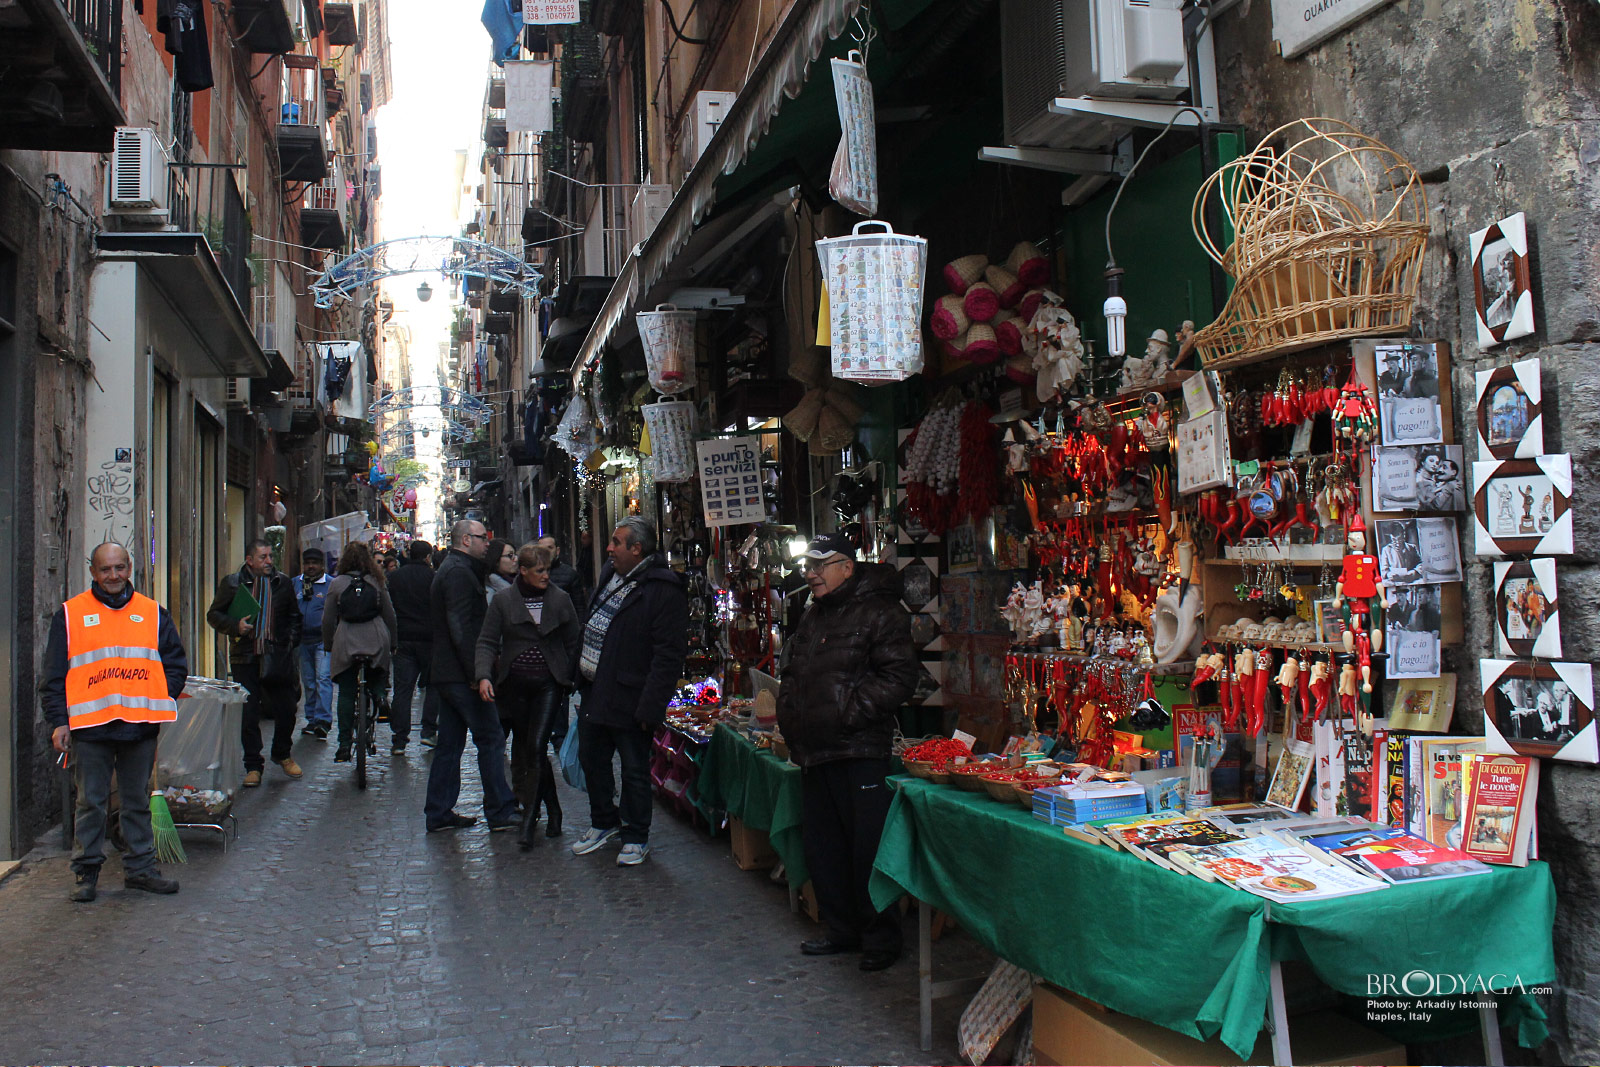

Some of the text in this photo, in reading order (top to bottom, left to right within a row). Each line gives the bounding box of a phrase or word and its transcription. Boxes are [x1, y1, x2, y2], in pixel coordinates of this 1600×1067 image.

[1398, 420, 1429, 433] pago!!!
[705, 460, 756, 476] servizi
[1400, 654, 1430, 666] pago!!!
[1481, 764, 1523, 774] DI GIACOMO
[1491, 774, 1512, 783] Tutte
[1480, 781, 1519, 791] le novelle
